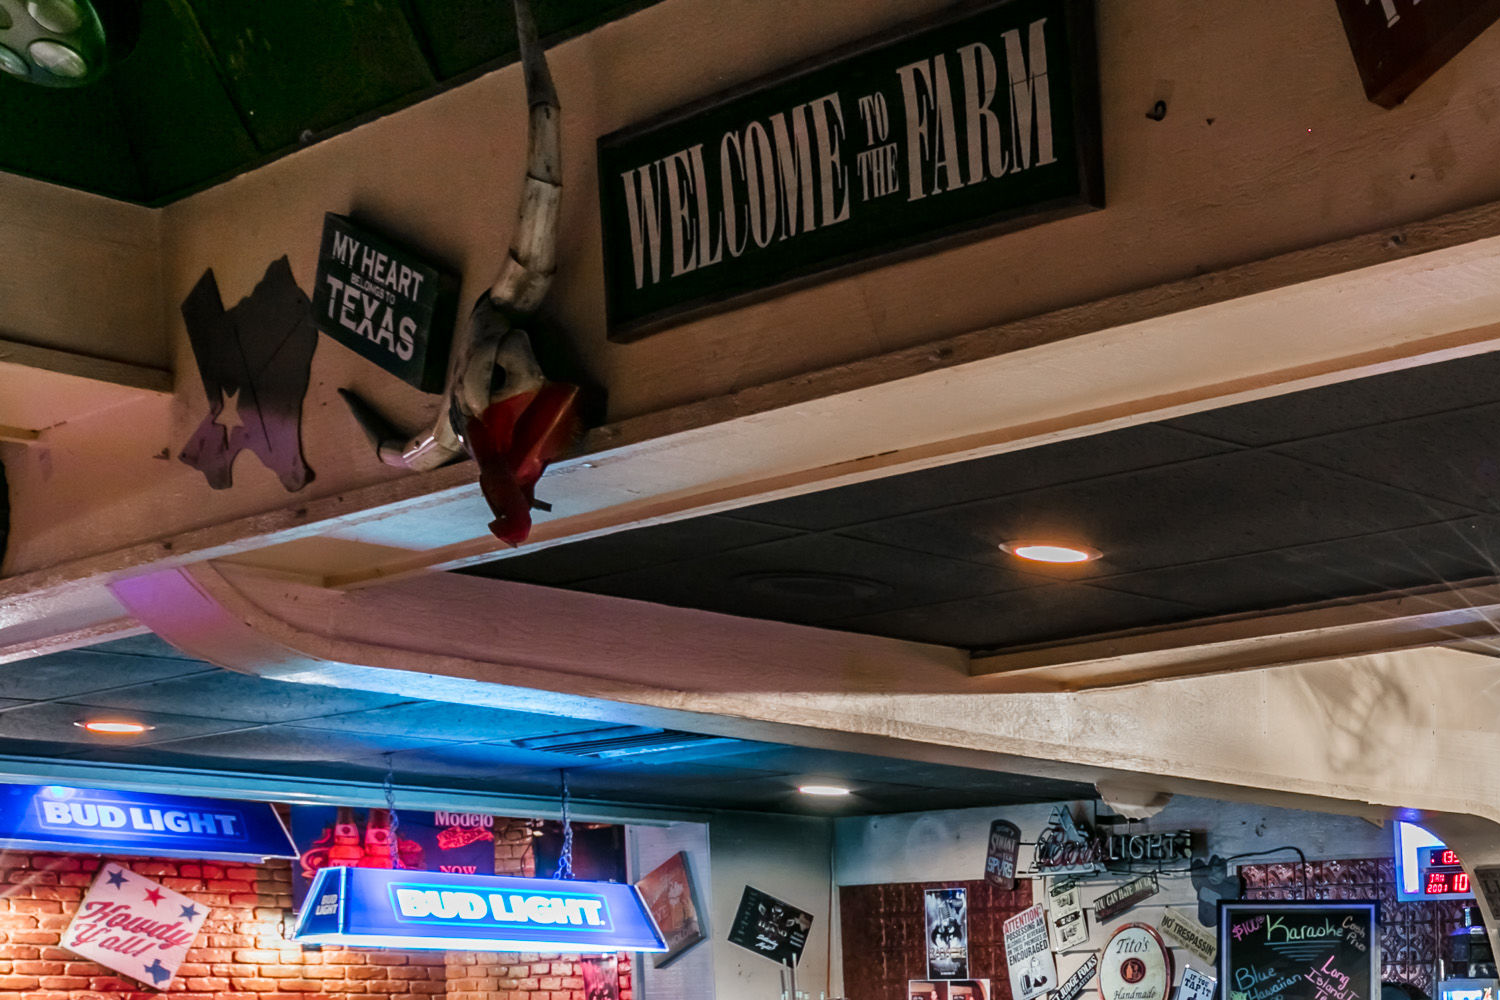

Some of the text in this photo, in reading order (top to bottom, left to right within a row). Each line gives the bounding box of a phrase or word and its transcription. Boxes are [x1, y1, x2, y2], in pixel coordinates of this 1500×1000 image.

[858, 91, 890, 147] TO
[896, 17, 1058, 202] FARM
[857, 142, 899, 201] THE
[620, 91, 850, 290] WELCOME
[332, 230, 424, 302] MY HEART
[350, 272, 396, 305] BELONGS TO
[326, 274, 417, 361] TEXAS
[42, 800, 240, 837] BUD LIGHT
[434, 810, 494, 828] Modelo
[1109, 834, 1177, 861] LIGHT
[397, 889, 604, 926] BUD LIGHT
[78, 901, 194, 951] Howdy
[1006, 923, 1036, 940] POSSESSING
[1266, 914, 1344, 942] Karaoke
[1009, 940, 1049, 967] ENCOURAGED
[1116, 937, 1150, 954] Tito's
[1060, 974, 1080, 999] JUDGE
[1184, 977, 1212, 998] TAP IT
[1235, 964, 1278, 991] Blue
[1304, 966, 1348, 1000] Island
[1320, 955, 1350, 990] Long
[1113, 986, 1157, 1000] Handmade
